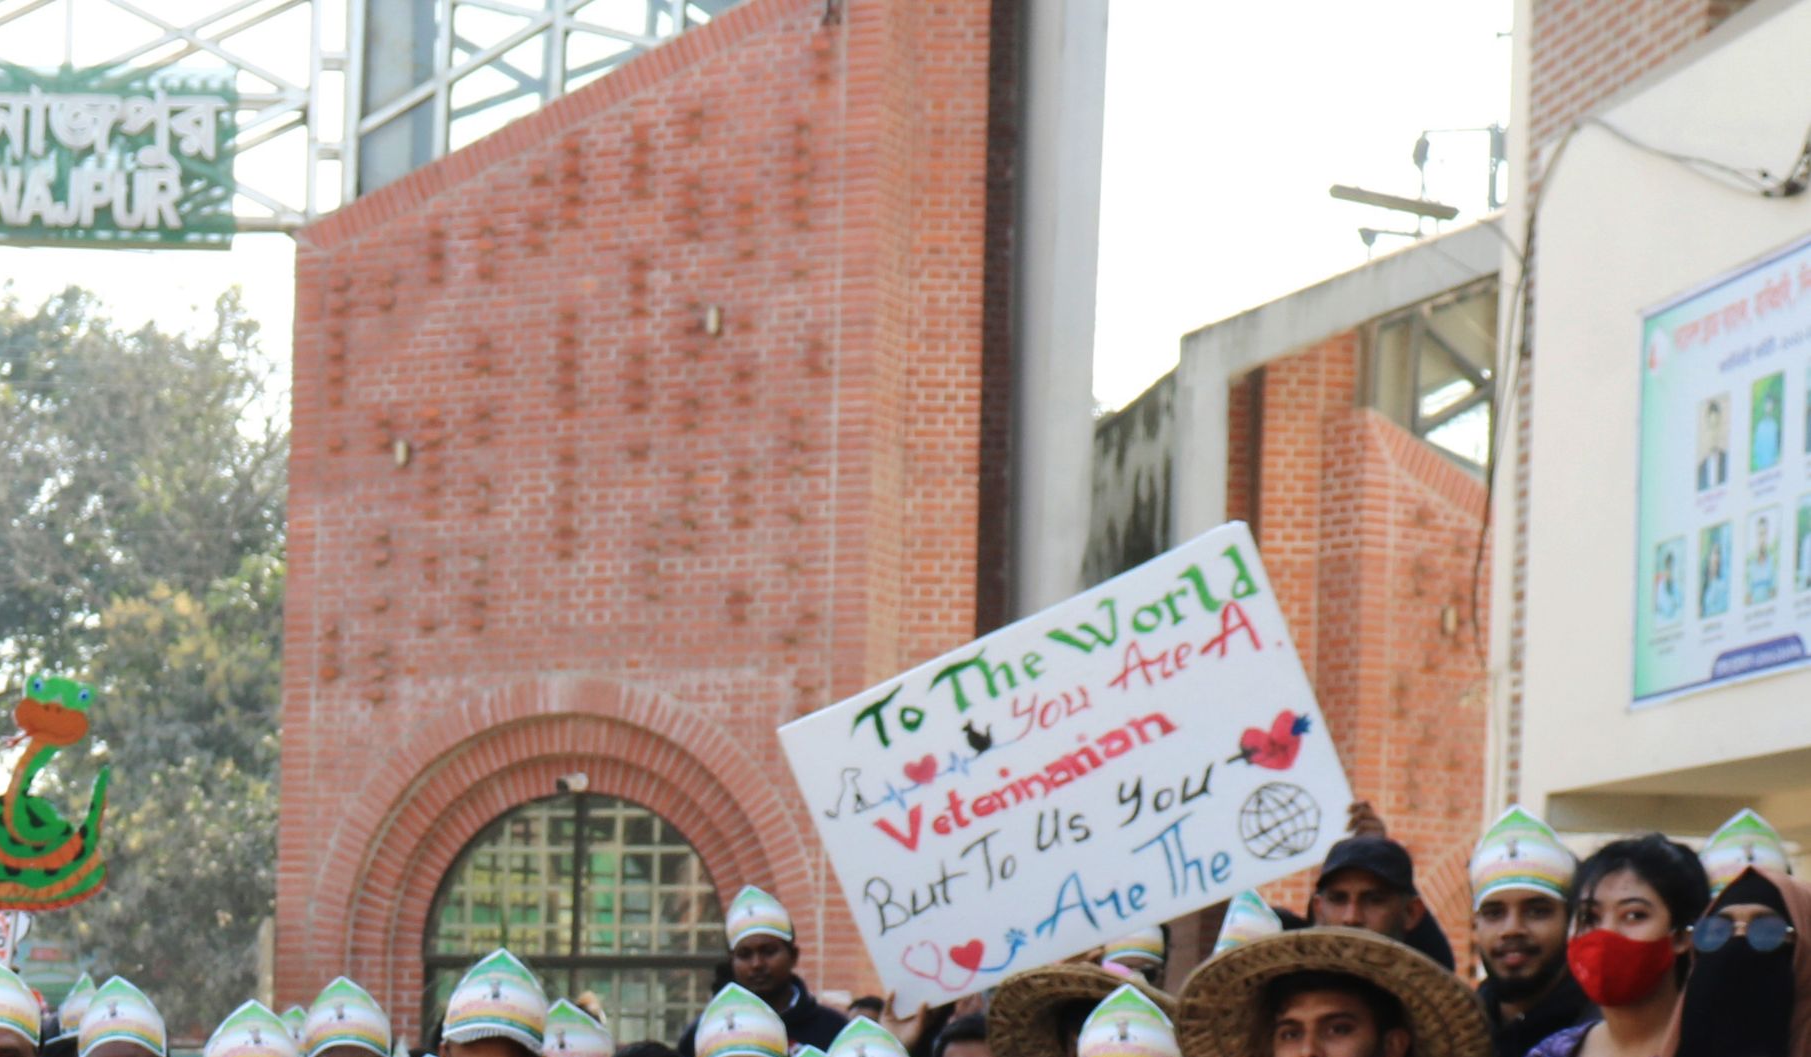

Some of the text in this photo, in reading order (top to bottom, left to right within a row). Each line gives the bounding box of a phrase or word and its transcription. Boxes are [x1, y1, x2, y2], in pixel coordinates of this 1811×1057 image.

[852, 543, 1262, 748] To The World
[1106, 639, 1193, 692] Are
[863, 860, 967, 936] But
[960, 829, 1017, 890] To
[1035, 811, 1232, 939] Are The
